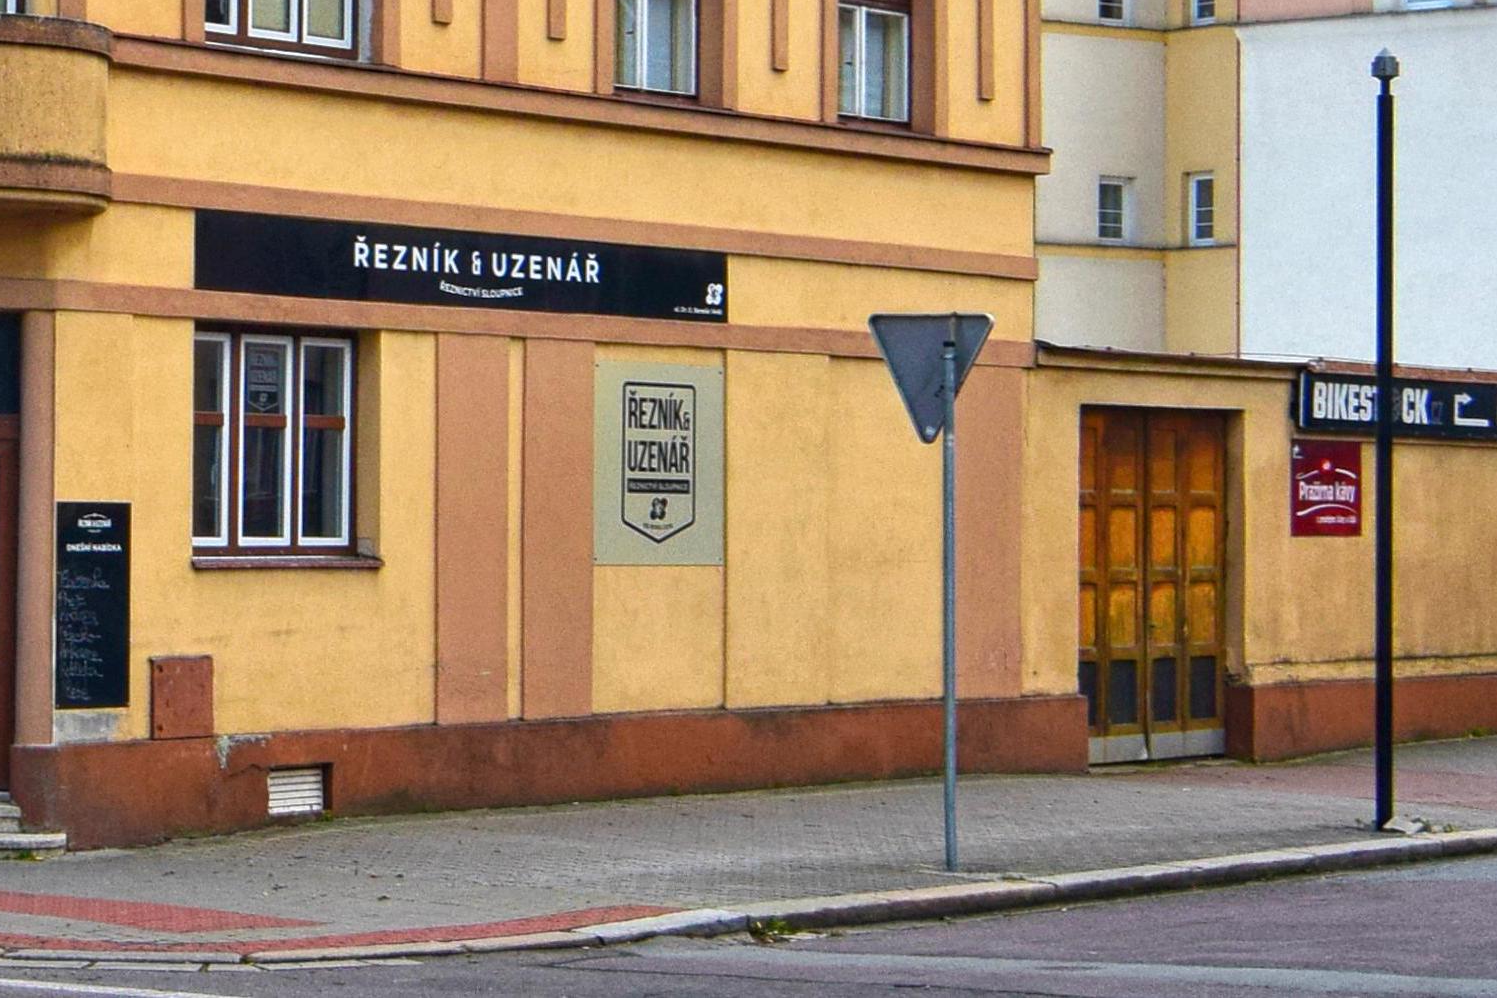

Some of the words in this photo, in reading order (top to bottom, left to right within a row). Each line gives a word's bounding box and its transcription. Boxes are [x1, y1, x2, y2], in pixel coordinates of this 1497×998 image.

[353, 235, 459, 275] ŘEZNÍK
[472, 251, 483, 276] &
[492, 253, 600, 284] UZENÁŘ
[627, 390, 684, 431] ŘEZNÍK
[627, 435, 690, 473] UZENÁŘ
